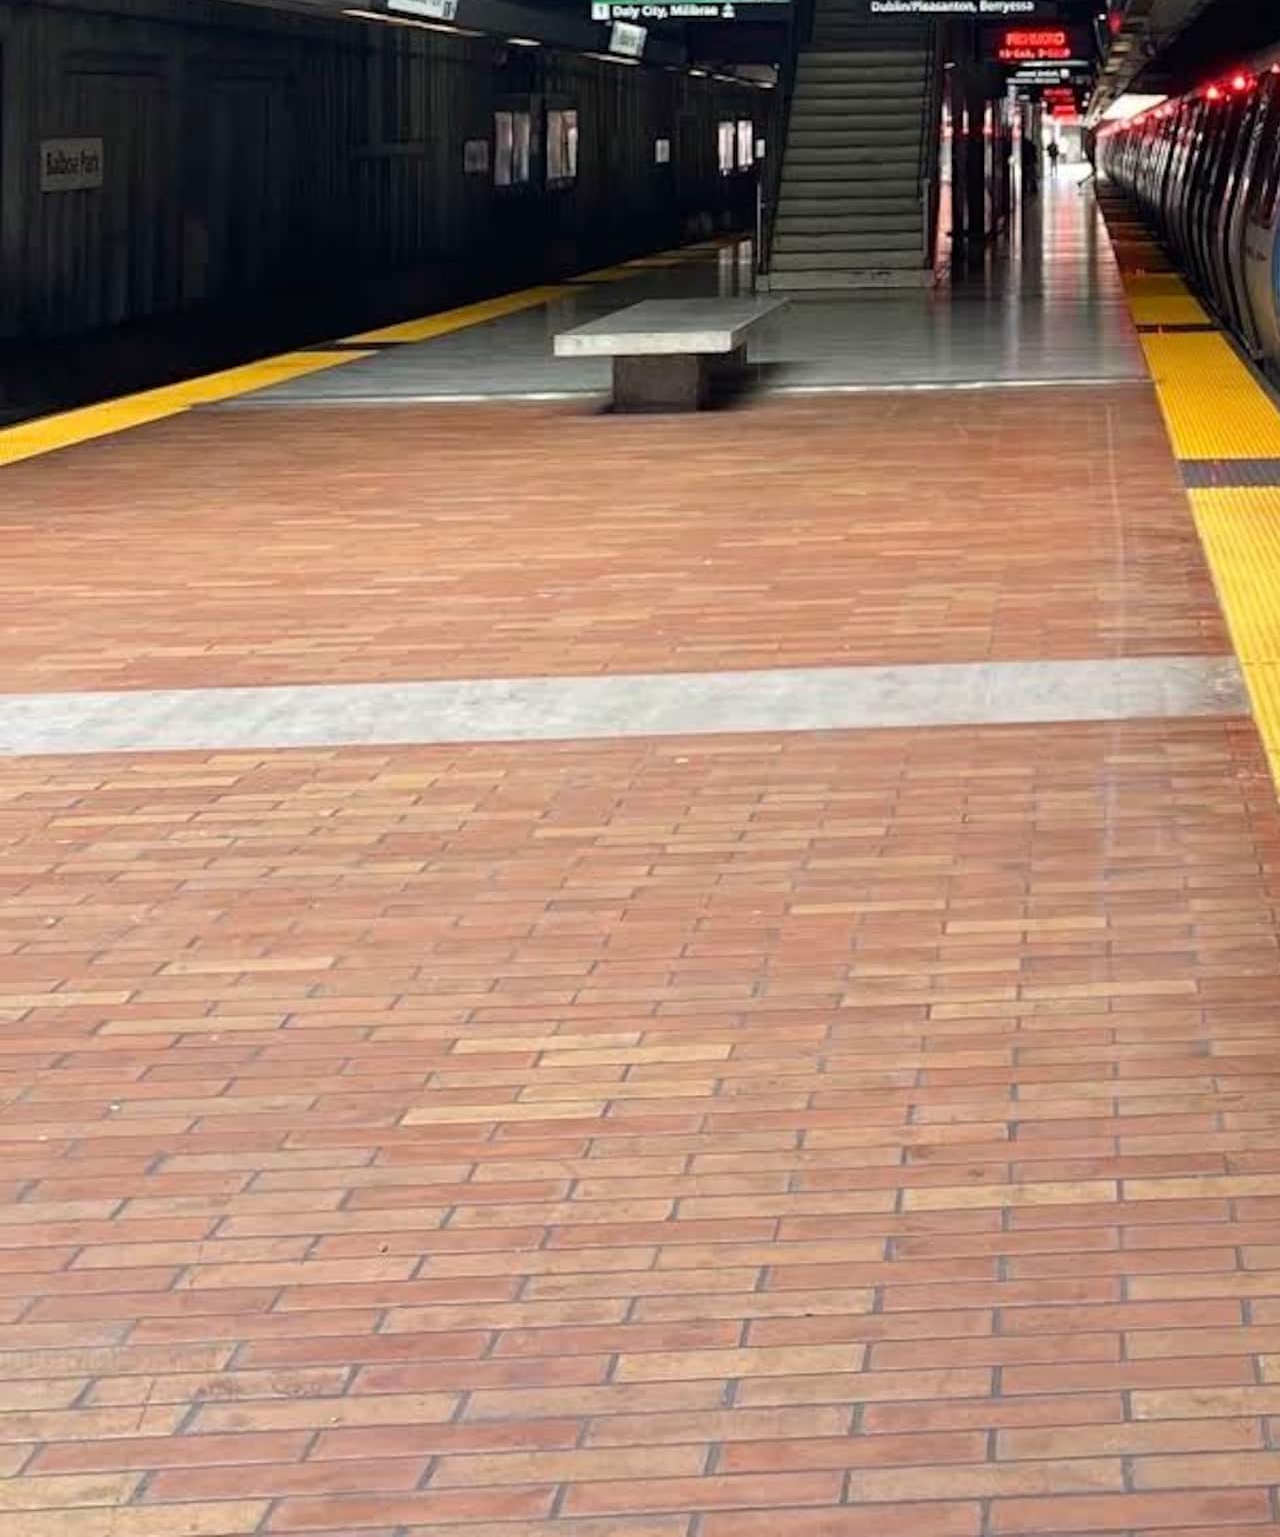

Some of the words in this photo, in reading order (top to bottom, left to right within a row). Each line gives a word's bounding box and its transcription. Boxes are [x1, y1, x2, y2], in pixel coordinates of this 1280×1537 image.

[612, 5, 640, 20] Daly
[641, 5, 668, 20] City,
[669, 4, 719, 17] Millbrae
